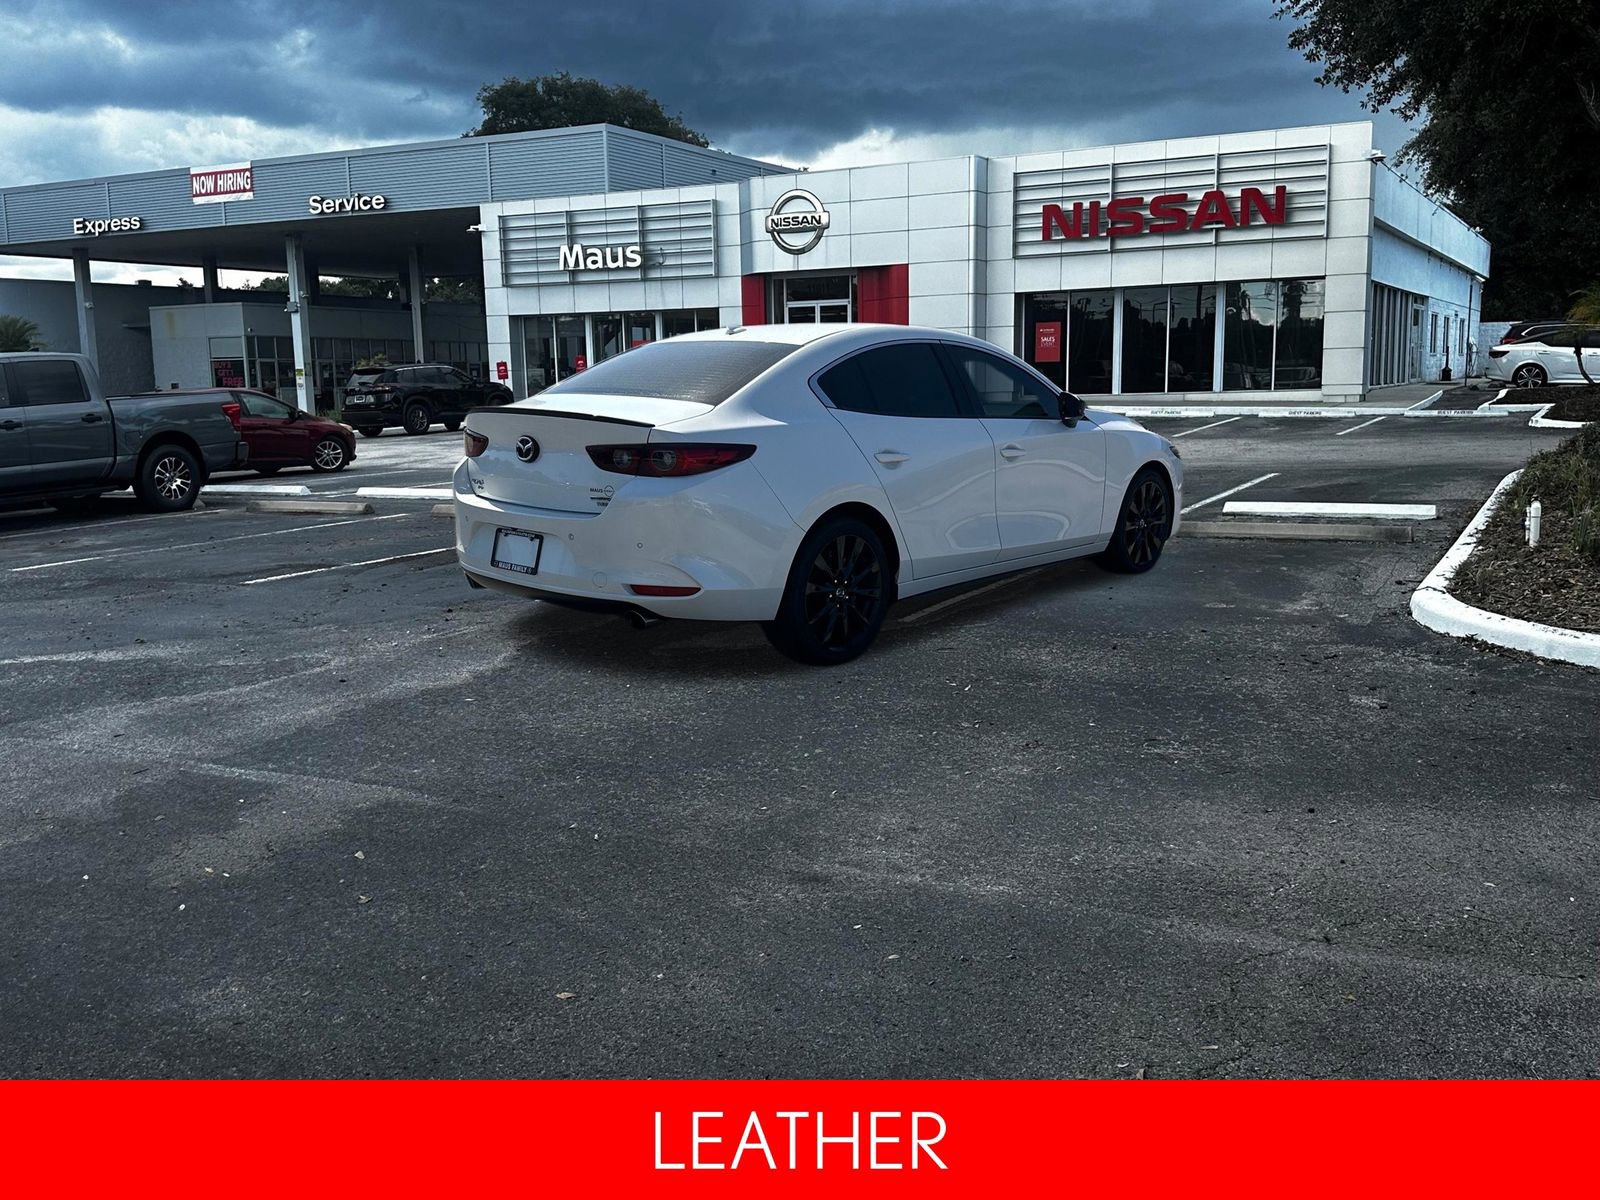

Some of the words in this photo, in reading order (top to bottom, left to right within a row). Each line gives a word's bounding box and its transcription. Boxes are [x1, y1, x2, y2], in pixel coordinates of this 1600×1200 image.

[193, 175, 215, 195] NOW
[217, 171, 251, 193] HIRING
[309, 193, 386, 216] Service
[1041, 185, 1287, 242] NISSAN
[73, 215, 142, 237] Express
[770, 215, 822, 229] NISSAN
[560, 243, 642, 271] Maus
[223, 377, 244, 386] FREE
